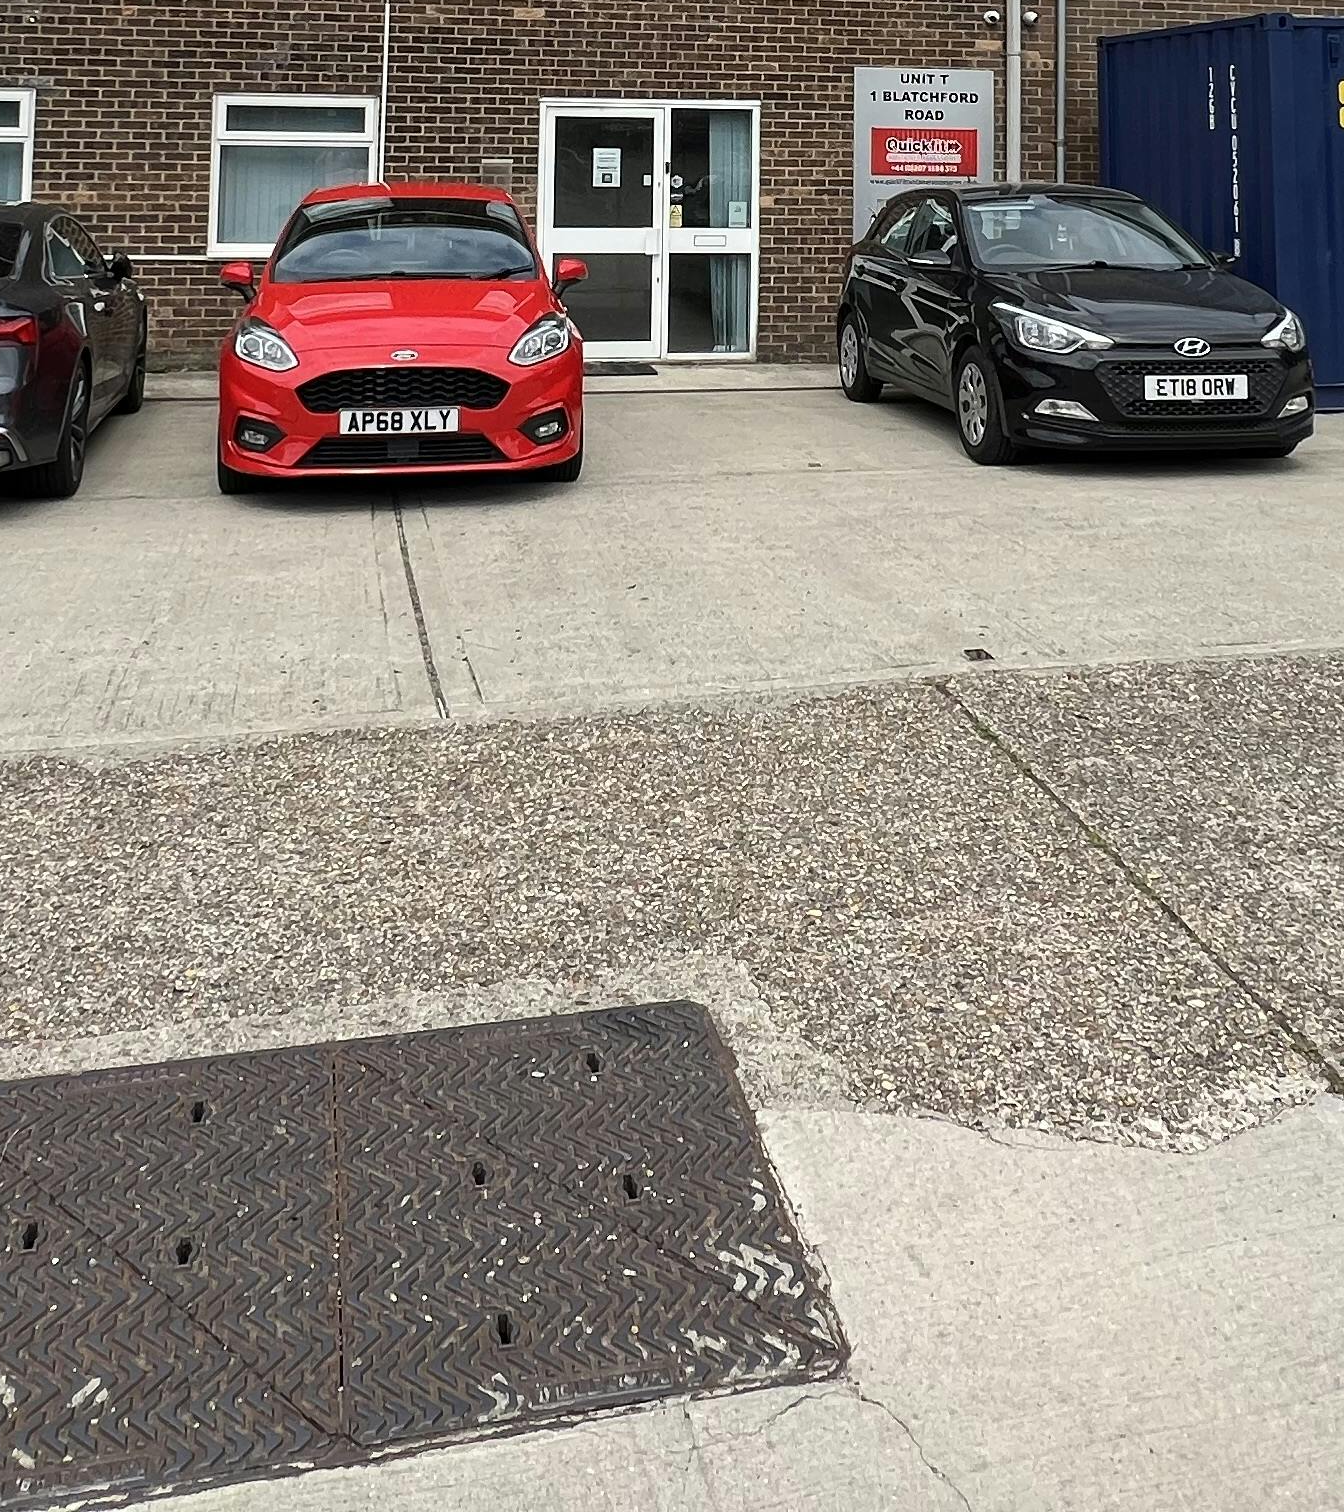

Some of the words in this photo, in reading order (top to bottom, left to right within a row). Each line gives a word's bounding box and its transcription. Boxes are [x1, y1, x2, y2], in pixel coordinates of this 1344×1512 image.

[900, 73, 935, 85] UNIT
[939, 74, 949, 85] T
[870, 90, 877, 101] 1
[882, 90, 979, 104] BLATCHFORD
[1229, 64, 1238, 130] CVCU
[904, 109, 945, 121] ROAD
[887, 138, 947, 153] Quickfit
[1231, 134, 1240, 233] 052061
[1156, 378, 1197, 397] ET18
[1202, 377, 1235, 396] ORW
[347, 412, 403, 432] AP68
[410, 409, 451, 431] XLY
